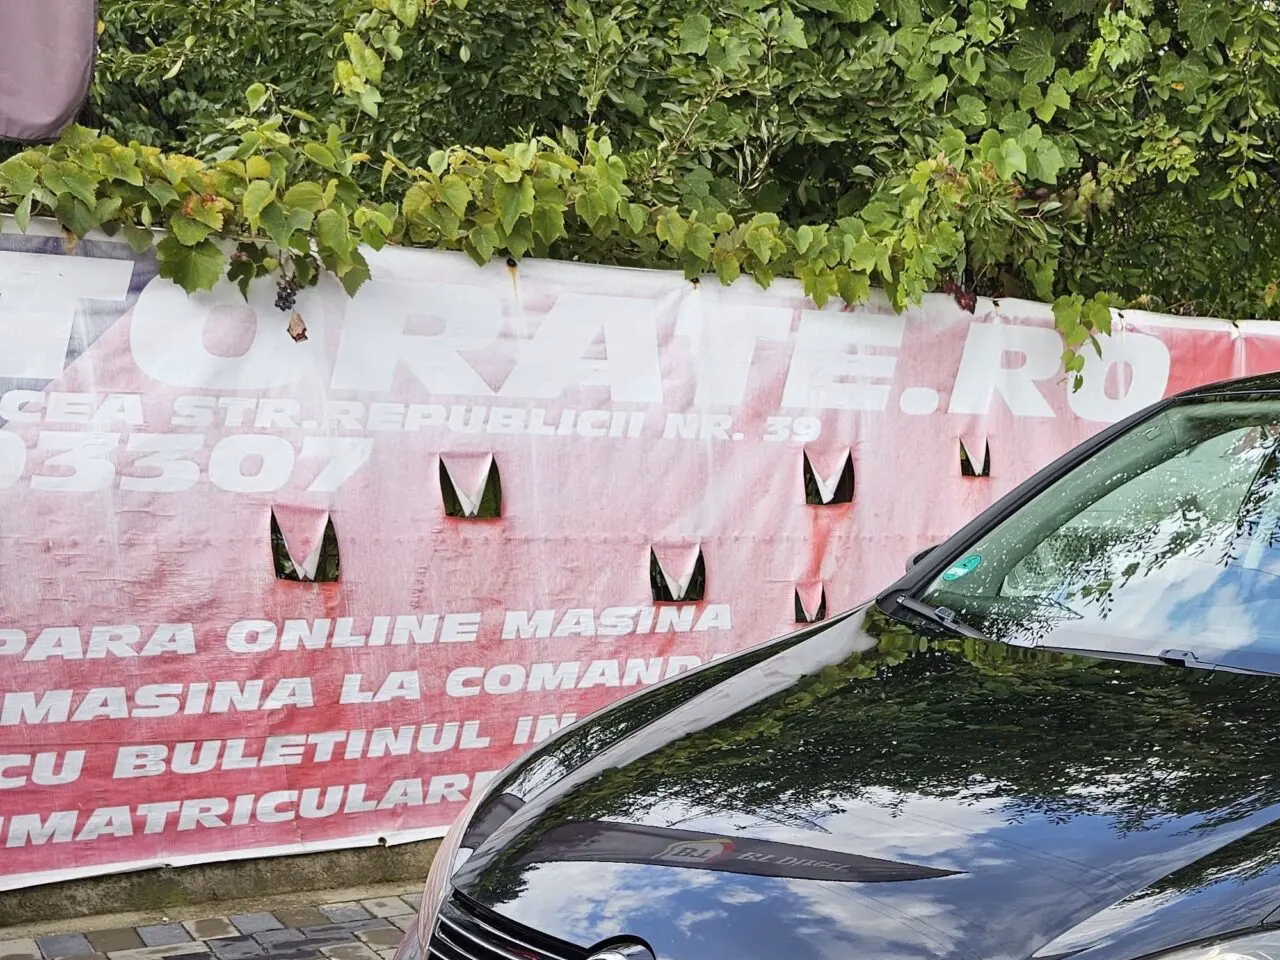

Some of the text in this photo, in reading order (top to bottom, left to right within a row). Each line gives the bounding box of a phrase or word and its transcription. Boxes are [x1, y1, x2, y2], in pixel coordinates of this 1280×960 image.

[662, 413, 744, 441] NR.
[762, 416, 822, 442] 39
[226, 612, 482, 654] ONLINE
[501, 603, 732, 641] MASINA
[0, 653, 734, 726] MASINA LA COMAND
[0, 749, 86, 790] CU
[113, 719, 491, 780] BULETINUL
[0, 769, 500, 849] MATRICULAR
